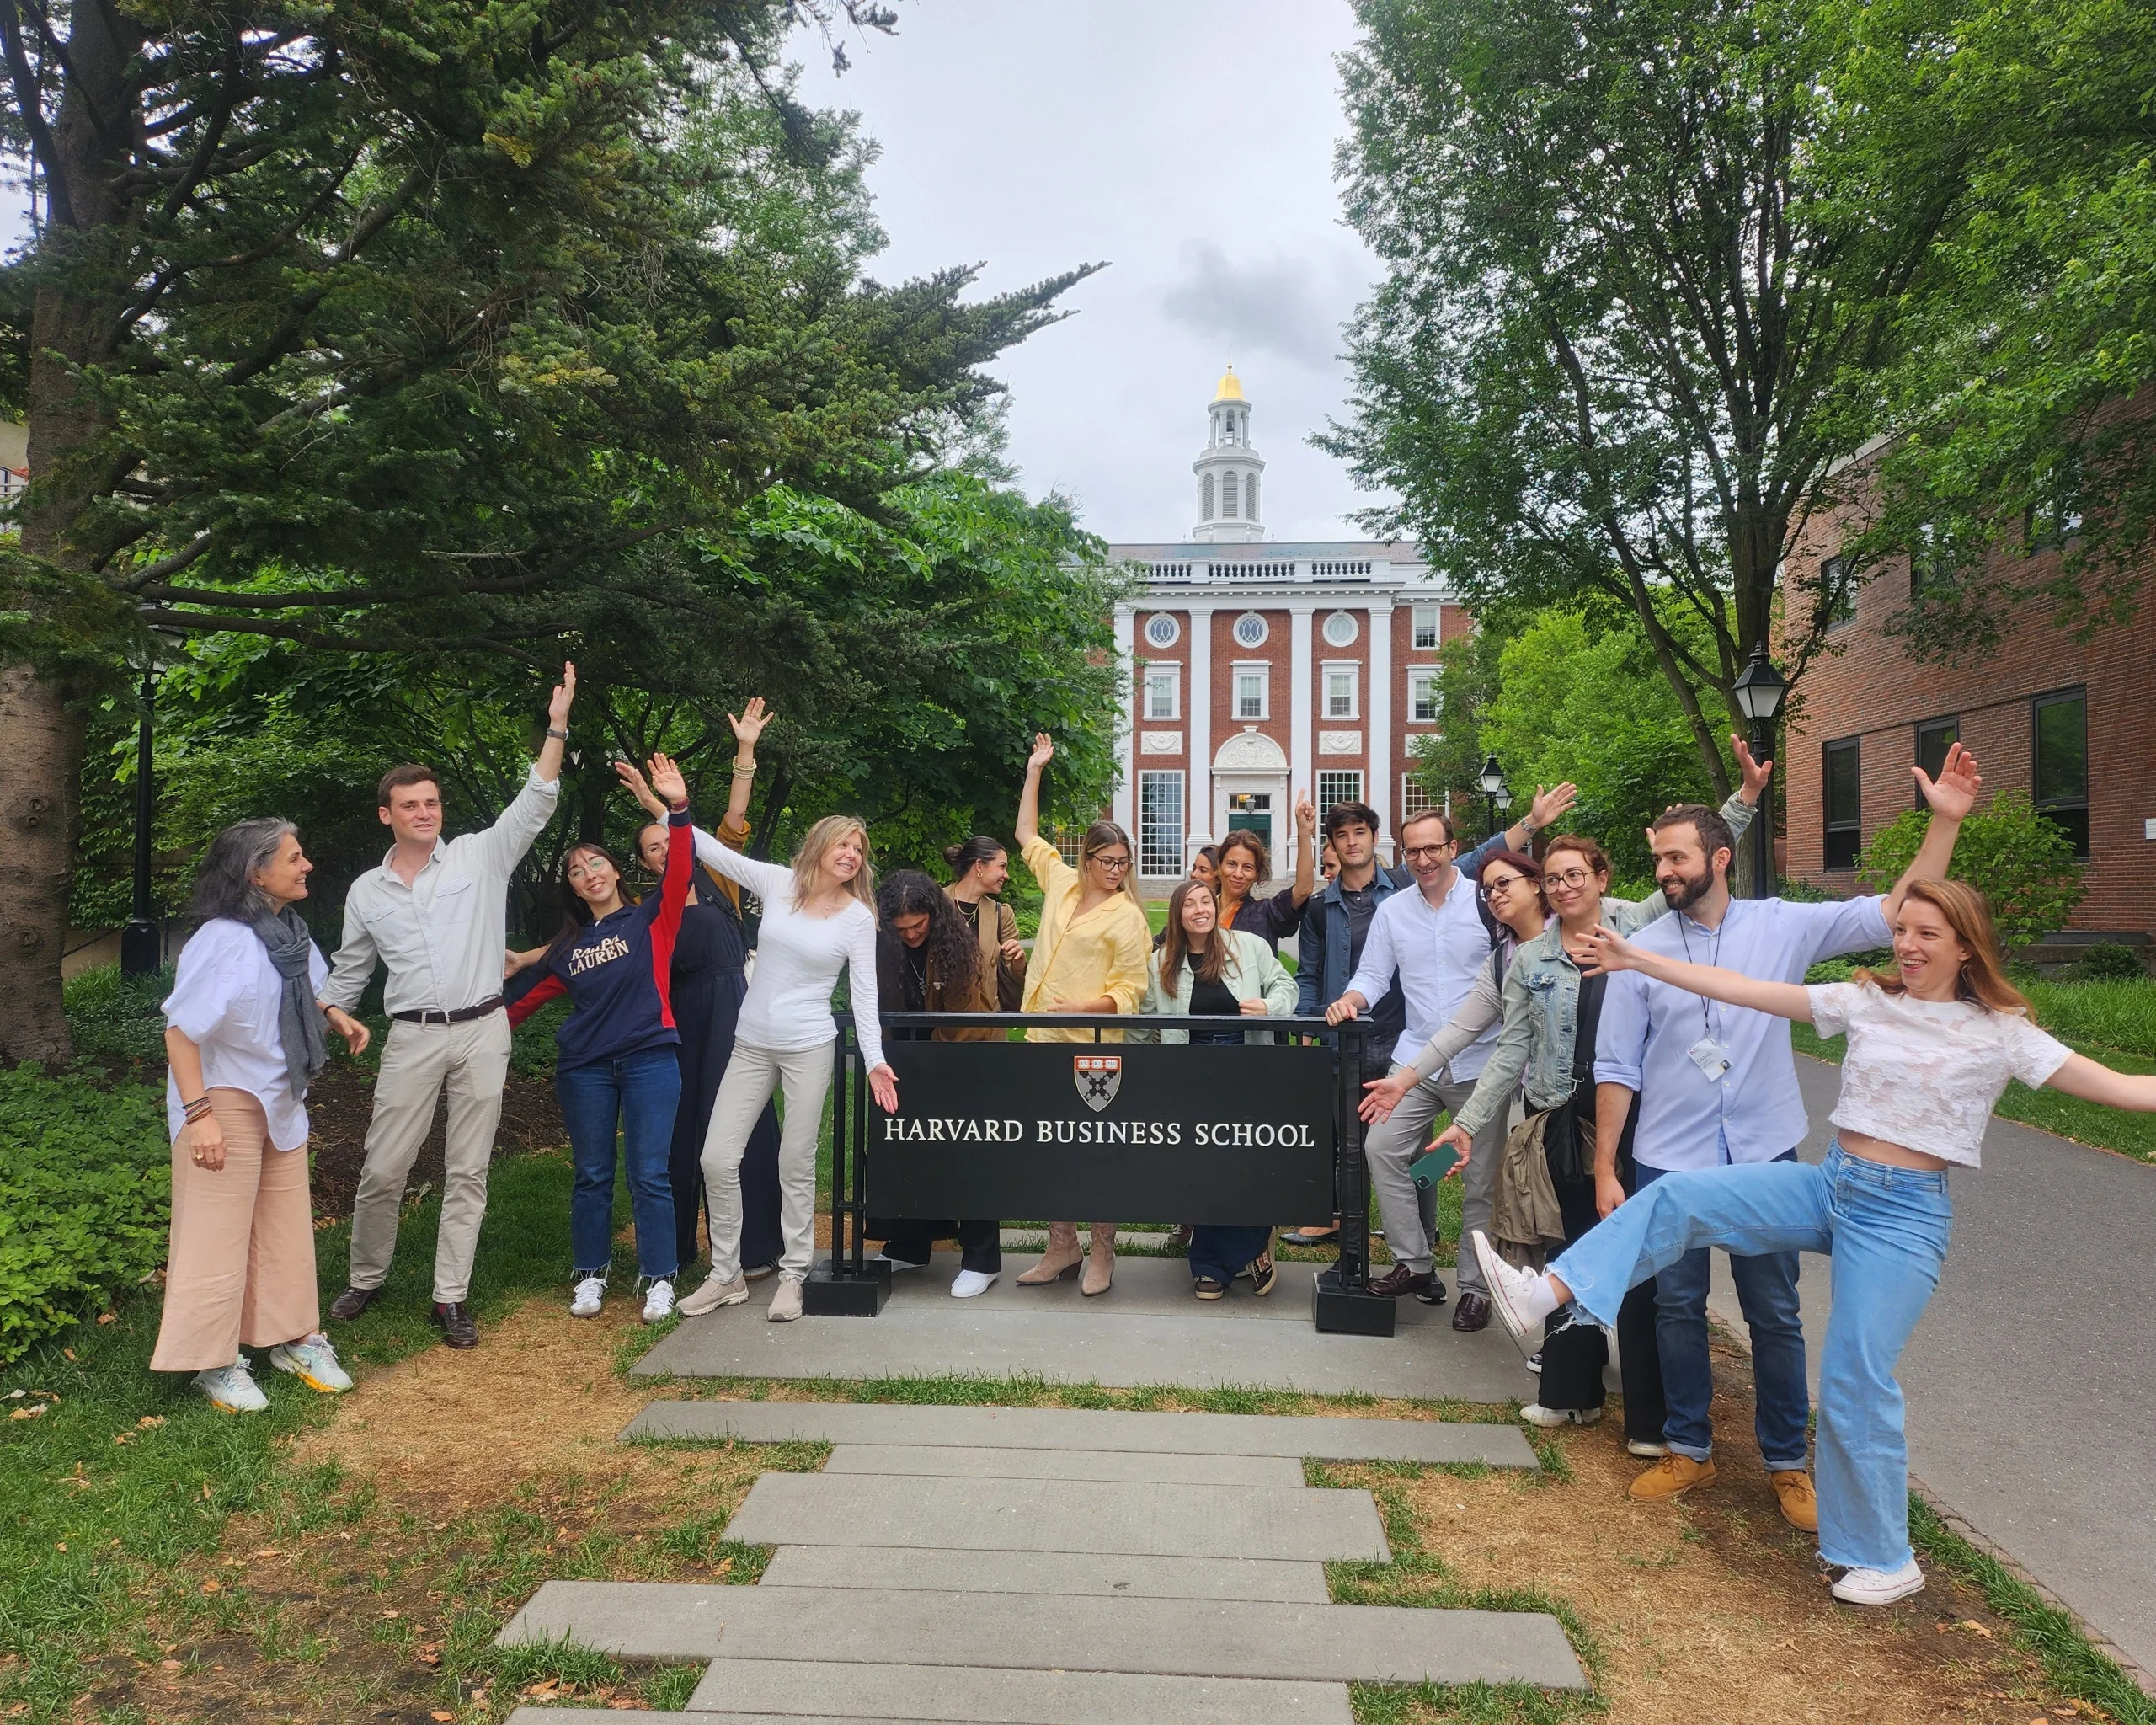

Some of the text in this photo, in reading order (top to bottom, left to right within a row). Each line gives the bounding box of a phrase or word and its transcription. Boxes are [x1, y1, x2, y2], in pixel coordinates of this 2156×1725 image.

[568, 940, 629, 977] LAUREN
[884, 1118, 1315, 1148] HARVARD BUSINESS SCHOOL
